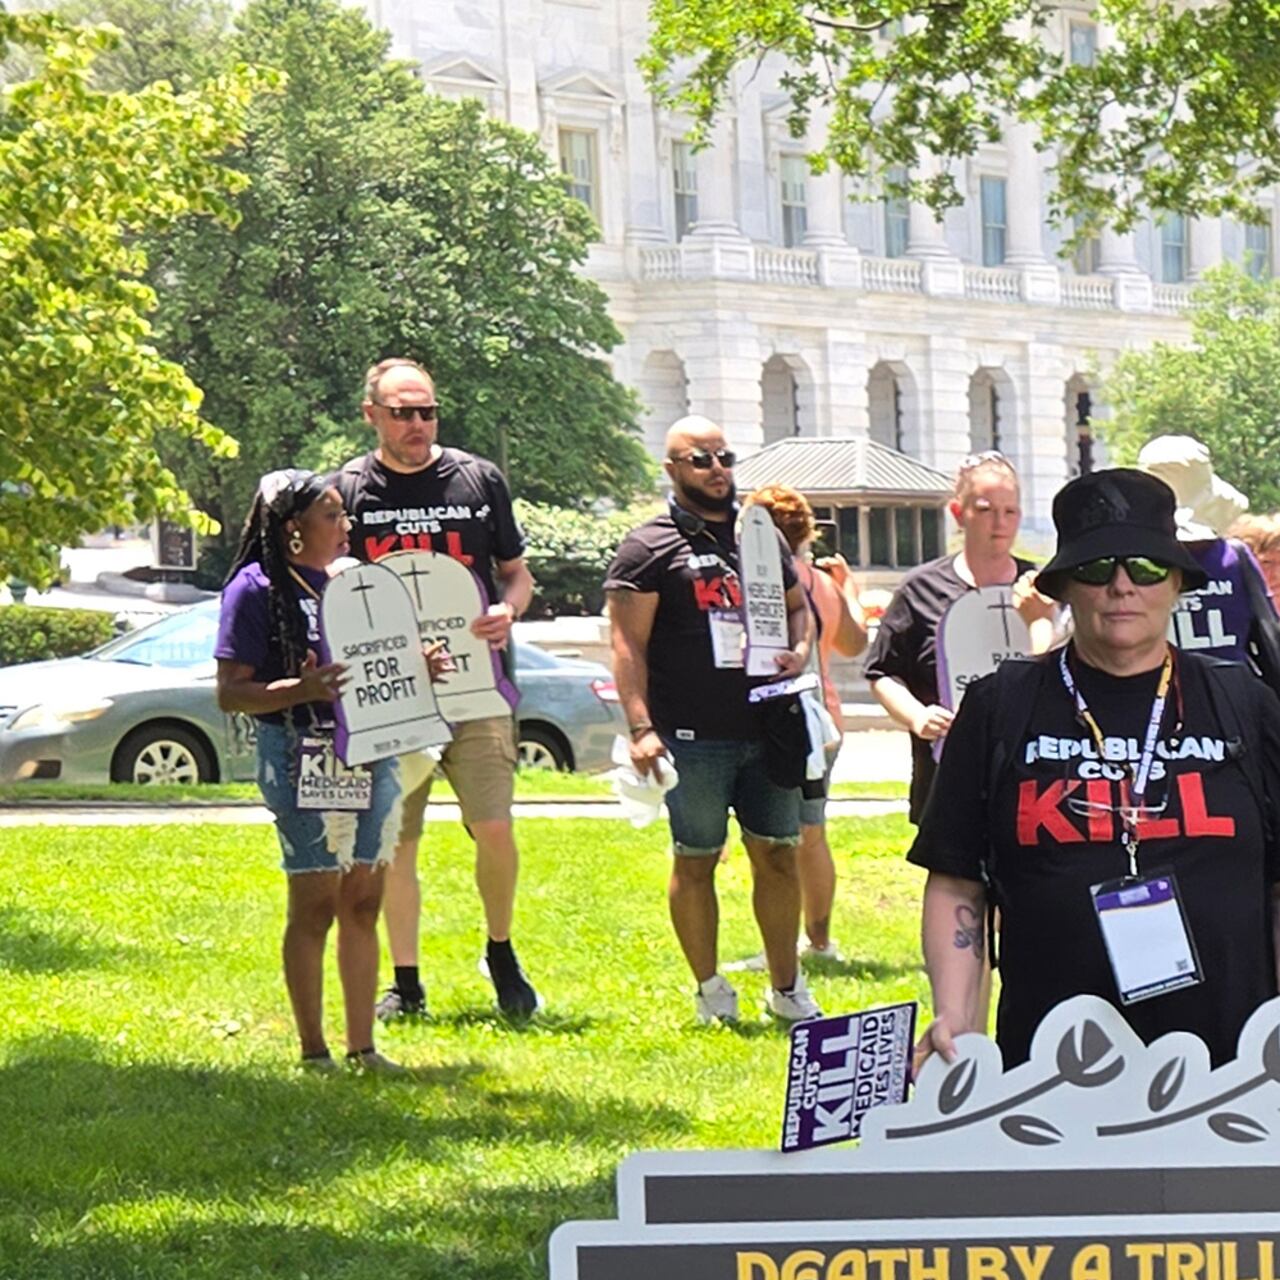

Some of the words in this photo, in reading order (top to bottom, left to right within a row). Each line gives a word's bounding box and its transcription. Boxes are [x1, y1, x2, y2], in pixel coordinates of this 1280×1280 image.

[363, 506, 472, 525] REPUBLICAN
[395, 520, 442, 535] CUTS
[342, 635, 408, 659] SACRIFICED
[364, 656, 400, 682] FOR
[355, 676, 417, 708] PROFIT
[1017, 772, 1236, 846] KILL
[878, 1011, 896, 1068] LIVES
[784, 1028, 810, 1148] REPUBLICAN
[802, 1061, 821, 1111] CUTS
[811, 1016, 861, 1142] KILL
